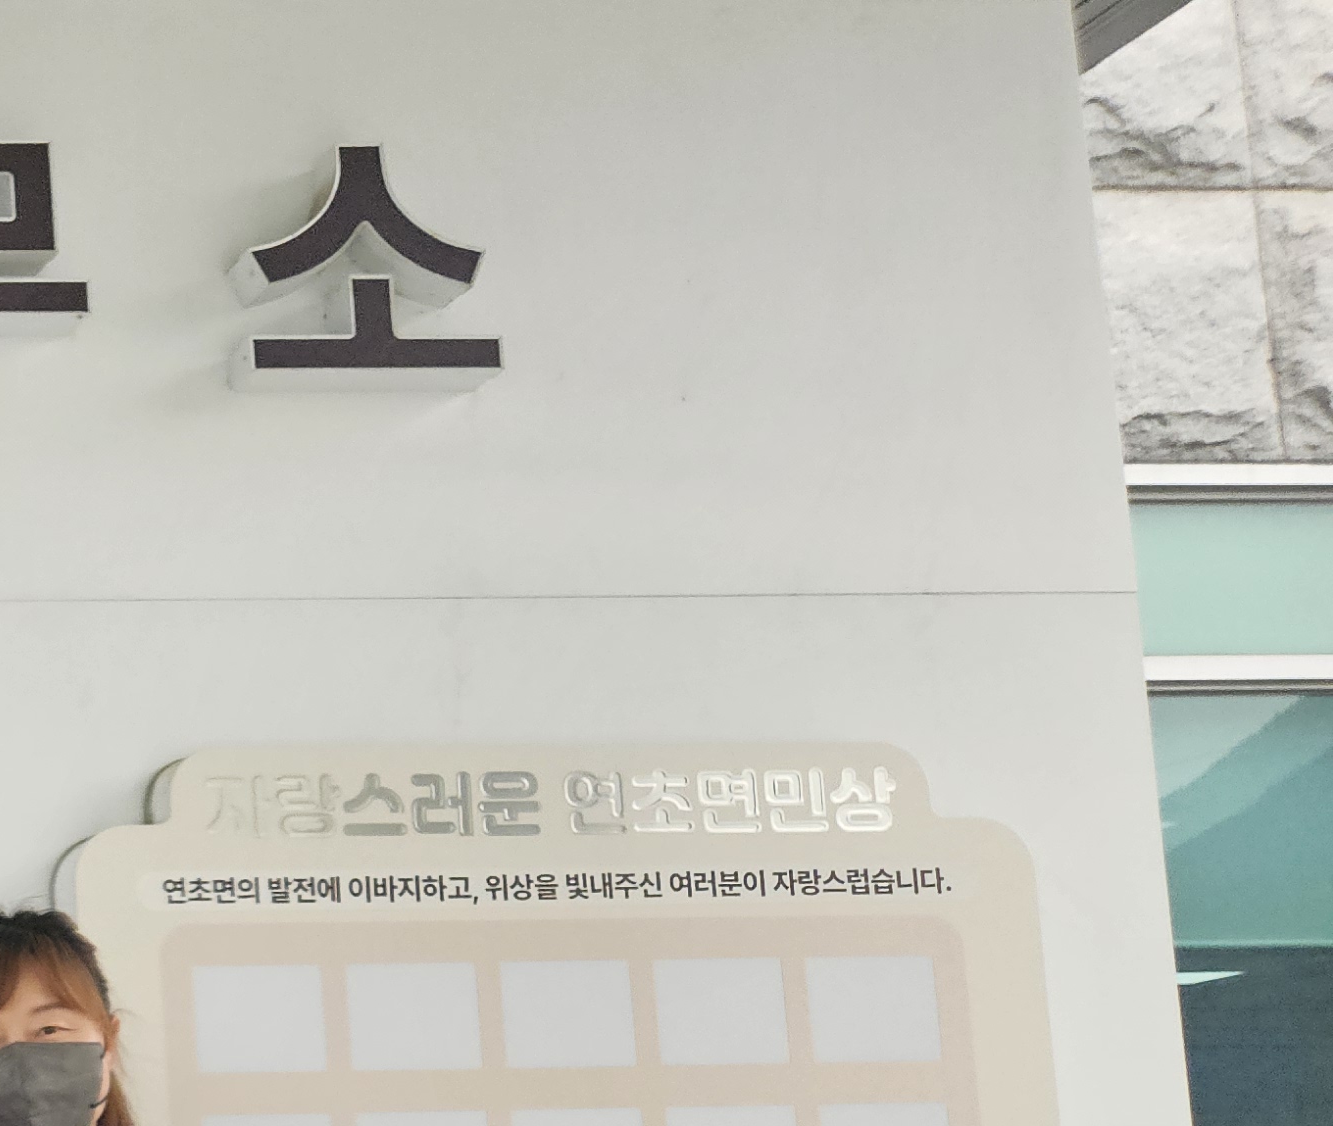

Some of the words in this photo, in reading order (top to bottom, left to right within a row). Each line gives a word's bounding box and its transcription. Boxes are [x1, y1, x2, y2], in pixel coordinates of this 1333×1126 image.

[205, 770, 541, 838] 자랑스러운
[564, 767, 896, 834] 연초면민상
[162, 876, 260, 904] 연초면의
[267, 875, 340, 903] 발전에
[348, 874, 478, 906] 이바지하고,
[484, 872, 558, 902] 위상을
[565, 870, 663, 900] 빛내주신
[669, 869, 766, 898] 여러분이
[772, 866, 952, 896] 자랑스럽습니다.
